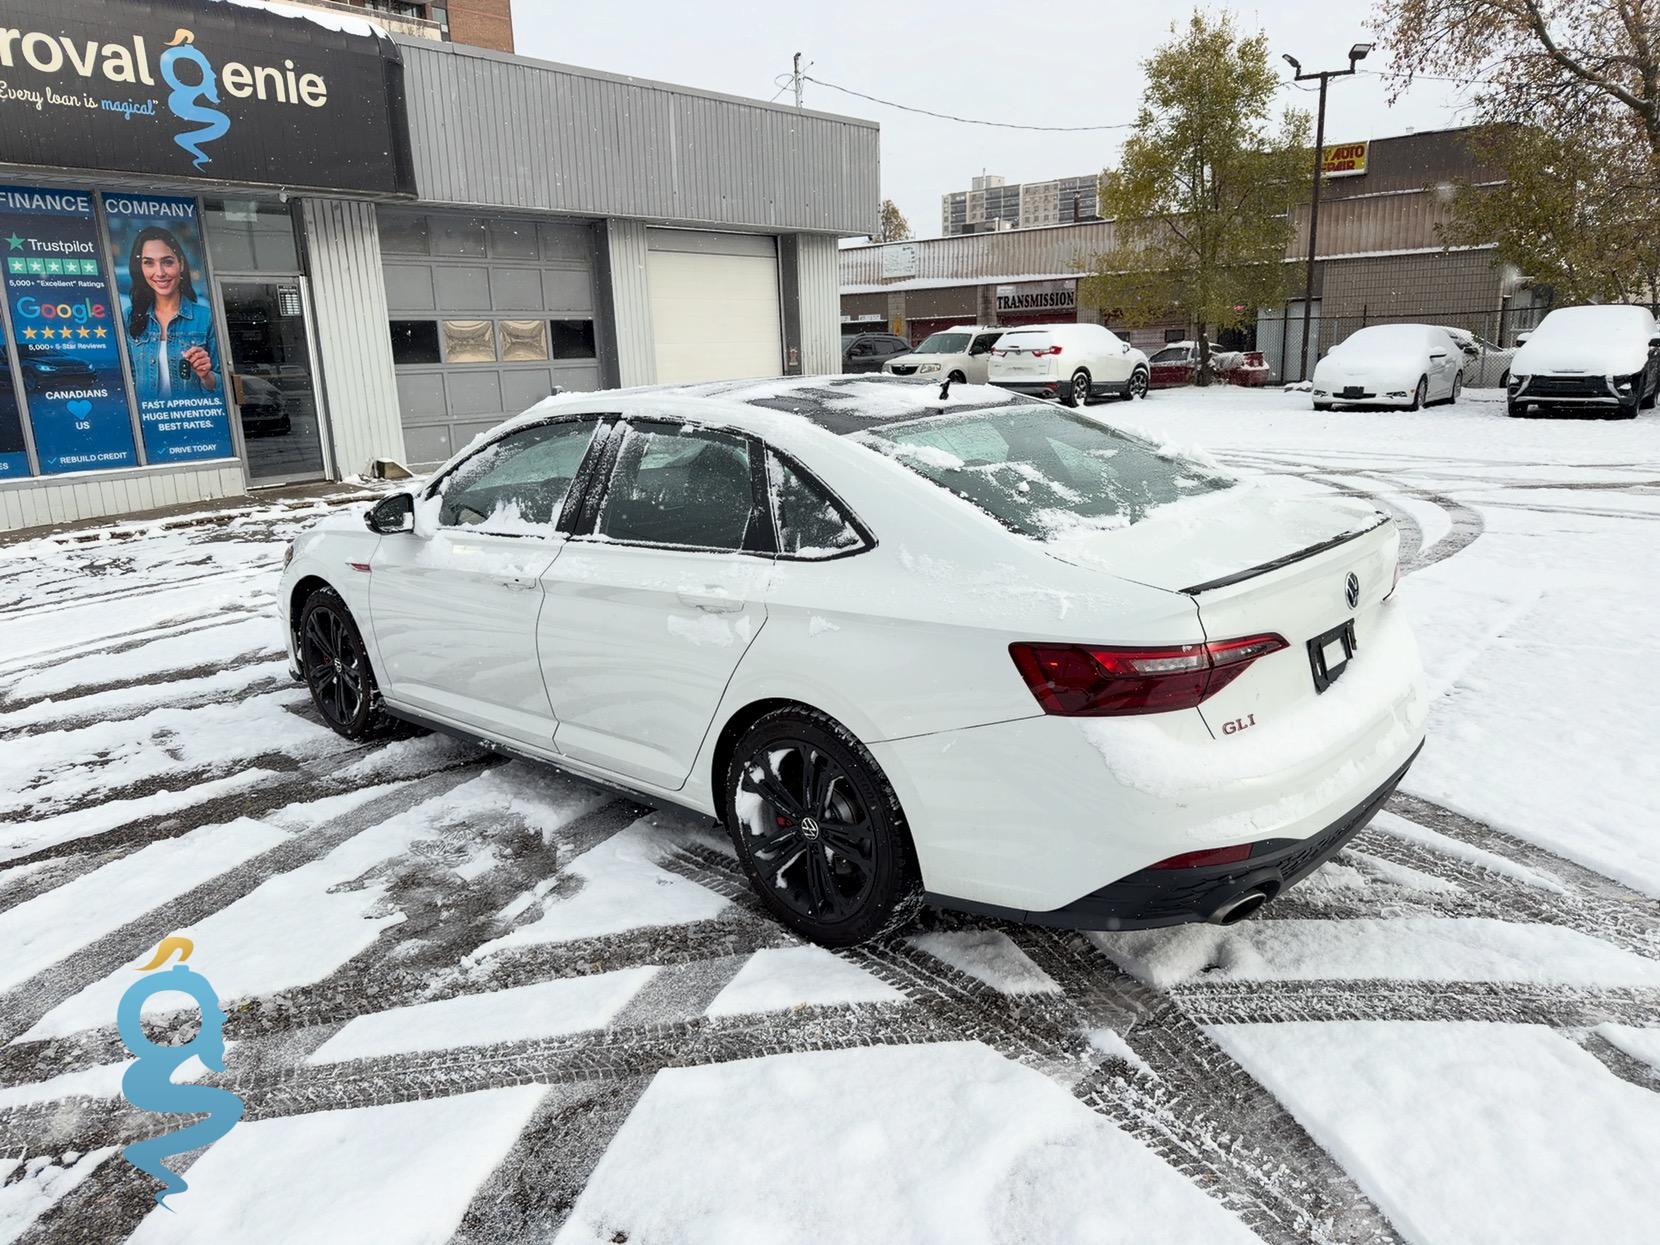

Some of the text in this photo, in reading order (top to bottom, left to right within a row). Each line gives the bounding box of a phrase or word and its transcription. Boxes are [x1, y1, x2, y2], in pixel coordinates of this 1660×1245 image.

[45, 86, 80, 107] loan
[83, 94, 98, 109] is
[1331, 145, 1365, 161] AUTO
[105, 198, 194, 217] COMPANY
[27, 238, 94, 254] Trustpilot
[9, 279, 35, 288] 5,000+
[78, 280, 105, 289] Ratings
[996, 291, 1075, 310] TRANSMISSION
[16, 296, 106, 324] Google
[28, 344, 54, 352] 5,000+
[77, 342, 107, 350] Reviews
[45, 389, 108, 400] CANADIANS
[142, 397, 223, 410] FAST APPROVALS.
[142, 408, 226, 421] HUGE INVENTORY.
[75, 421, 91, 430] US
[158, 420, 214, 432] BEST RATES.
[169, 443, 218, 455] DRIVE TODAY
[60, 451, 128, 465] REBUILD CREDIT
[1222, 713, 1256, 736] GLI
